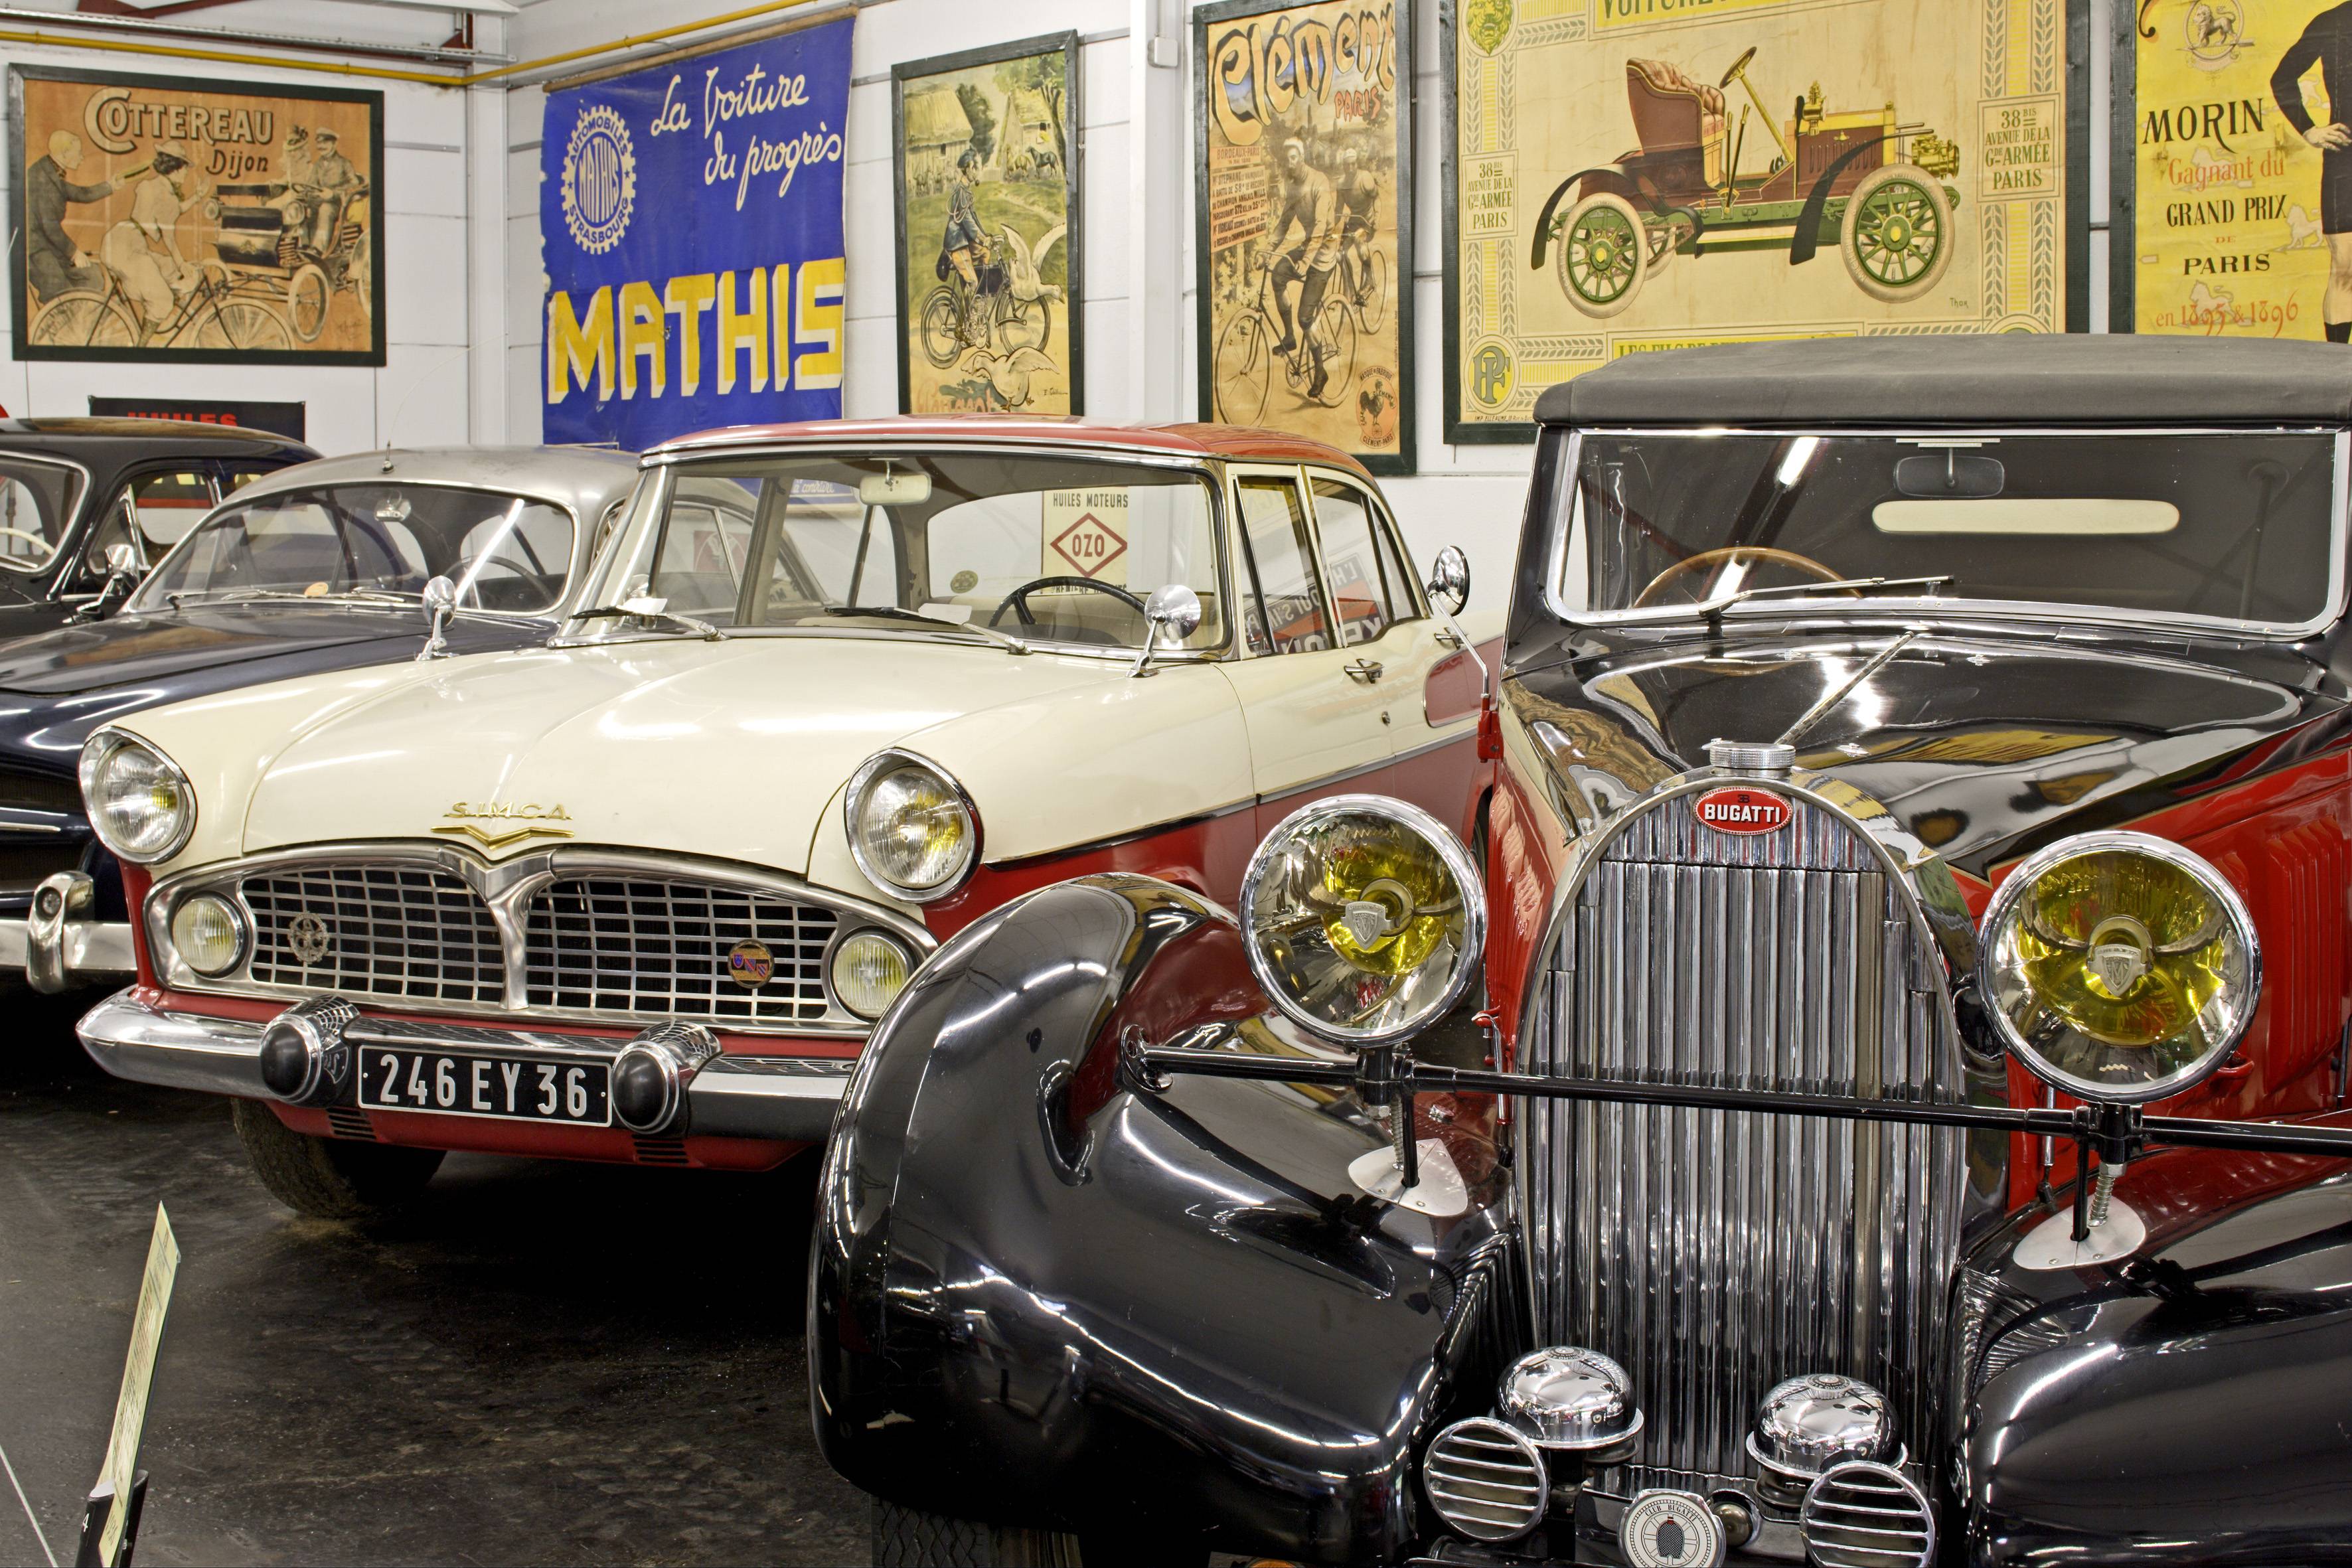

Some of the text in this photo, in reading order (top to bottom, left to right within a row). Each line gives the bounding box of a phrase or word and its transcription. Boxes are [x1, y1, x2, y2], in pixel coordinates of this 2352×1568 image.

[651, 64, 809, 139] La Voiture
[1334, 86, 1381, 121] PARIS
[84, 87, 274, 155] COTTEREAU
[2142, 98, 2265, 154] MORIN
[570, 116, 627, 166] AUTOMOBILES
[1986, 126, 2050, 145] AVENUE DE LA
[205, 147, 269, 179] Dijon
[705, 121, 842, 212] du progrès
[2003, 142, 2050, 165] ARMÉE
[579, 136, 619, 223] MATHIS
[1468, 177, 1512, 192] AVENUE DE LA
[1993, 169, 2042, 190] PARIS
[2169, 151, 2284, 193] Gagnant du
[1480, 190, 1512, 209] ARMÉE
[2167, 195, 2288, 228] GRAND PRIX
[570, 197, 629, 244] STRASBOURG
[1473, 212, 1507, 229] PARIS
[2215, 236, 2236, 244] DE
[2183, 254, 2270, 276] PARIS
[2156, 290, 2299, 339] en 1895 & 1896
[548, 256, 846, 404] MATHIS
[1054, 493, 1129, 508] HUILES MOTEURS
[1072, 534, 1105, 557] OZO
[445, 801, 573, 820] SIMCA
[1704, 804, 1780, 823] BUGATTI
[380, 1054, 587, 1118] 246 EY 36
[82, 1514, 90, 1533] 4
[1645, 1504, 1697, 1522] CLUB BUGATTI
